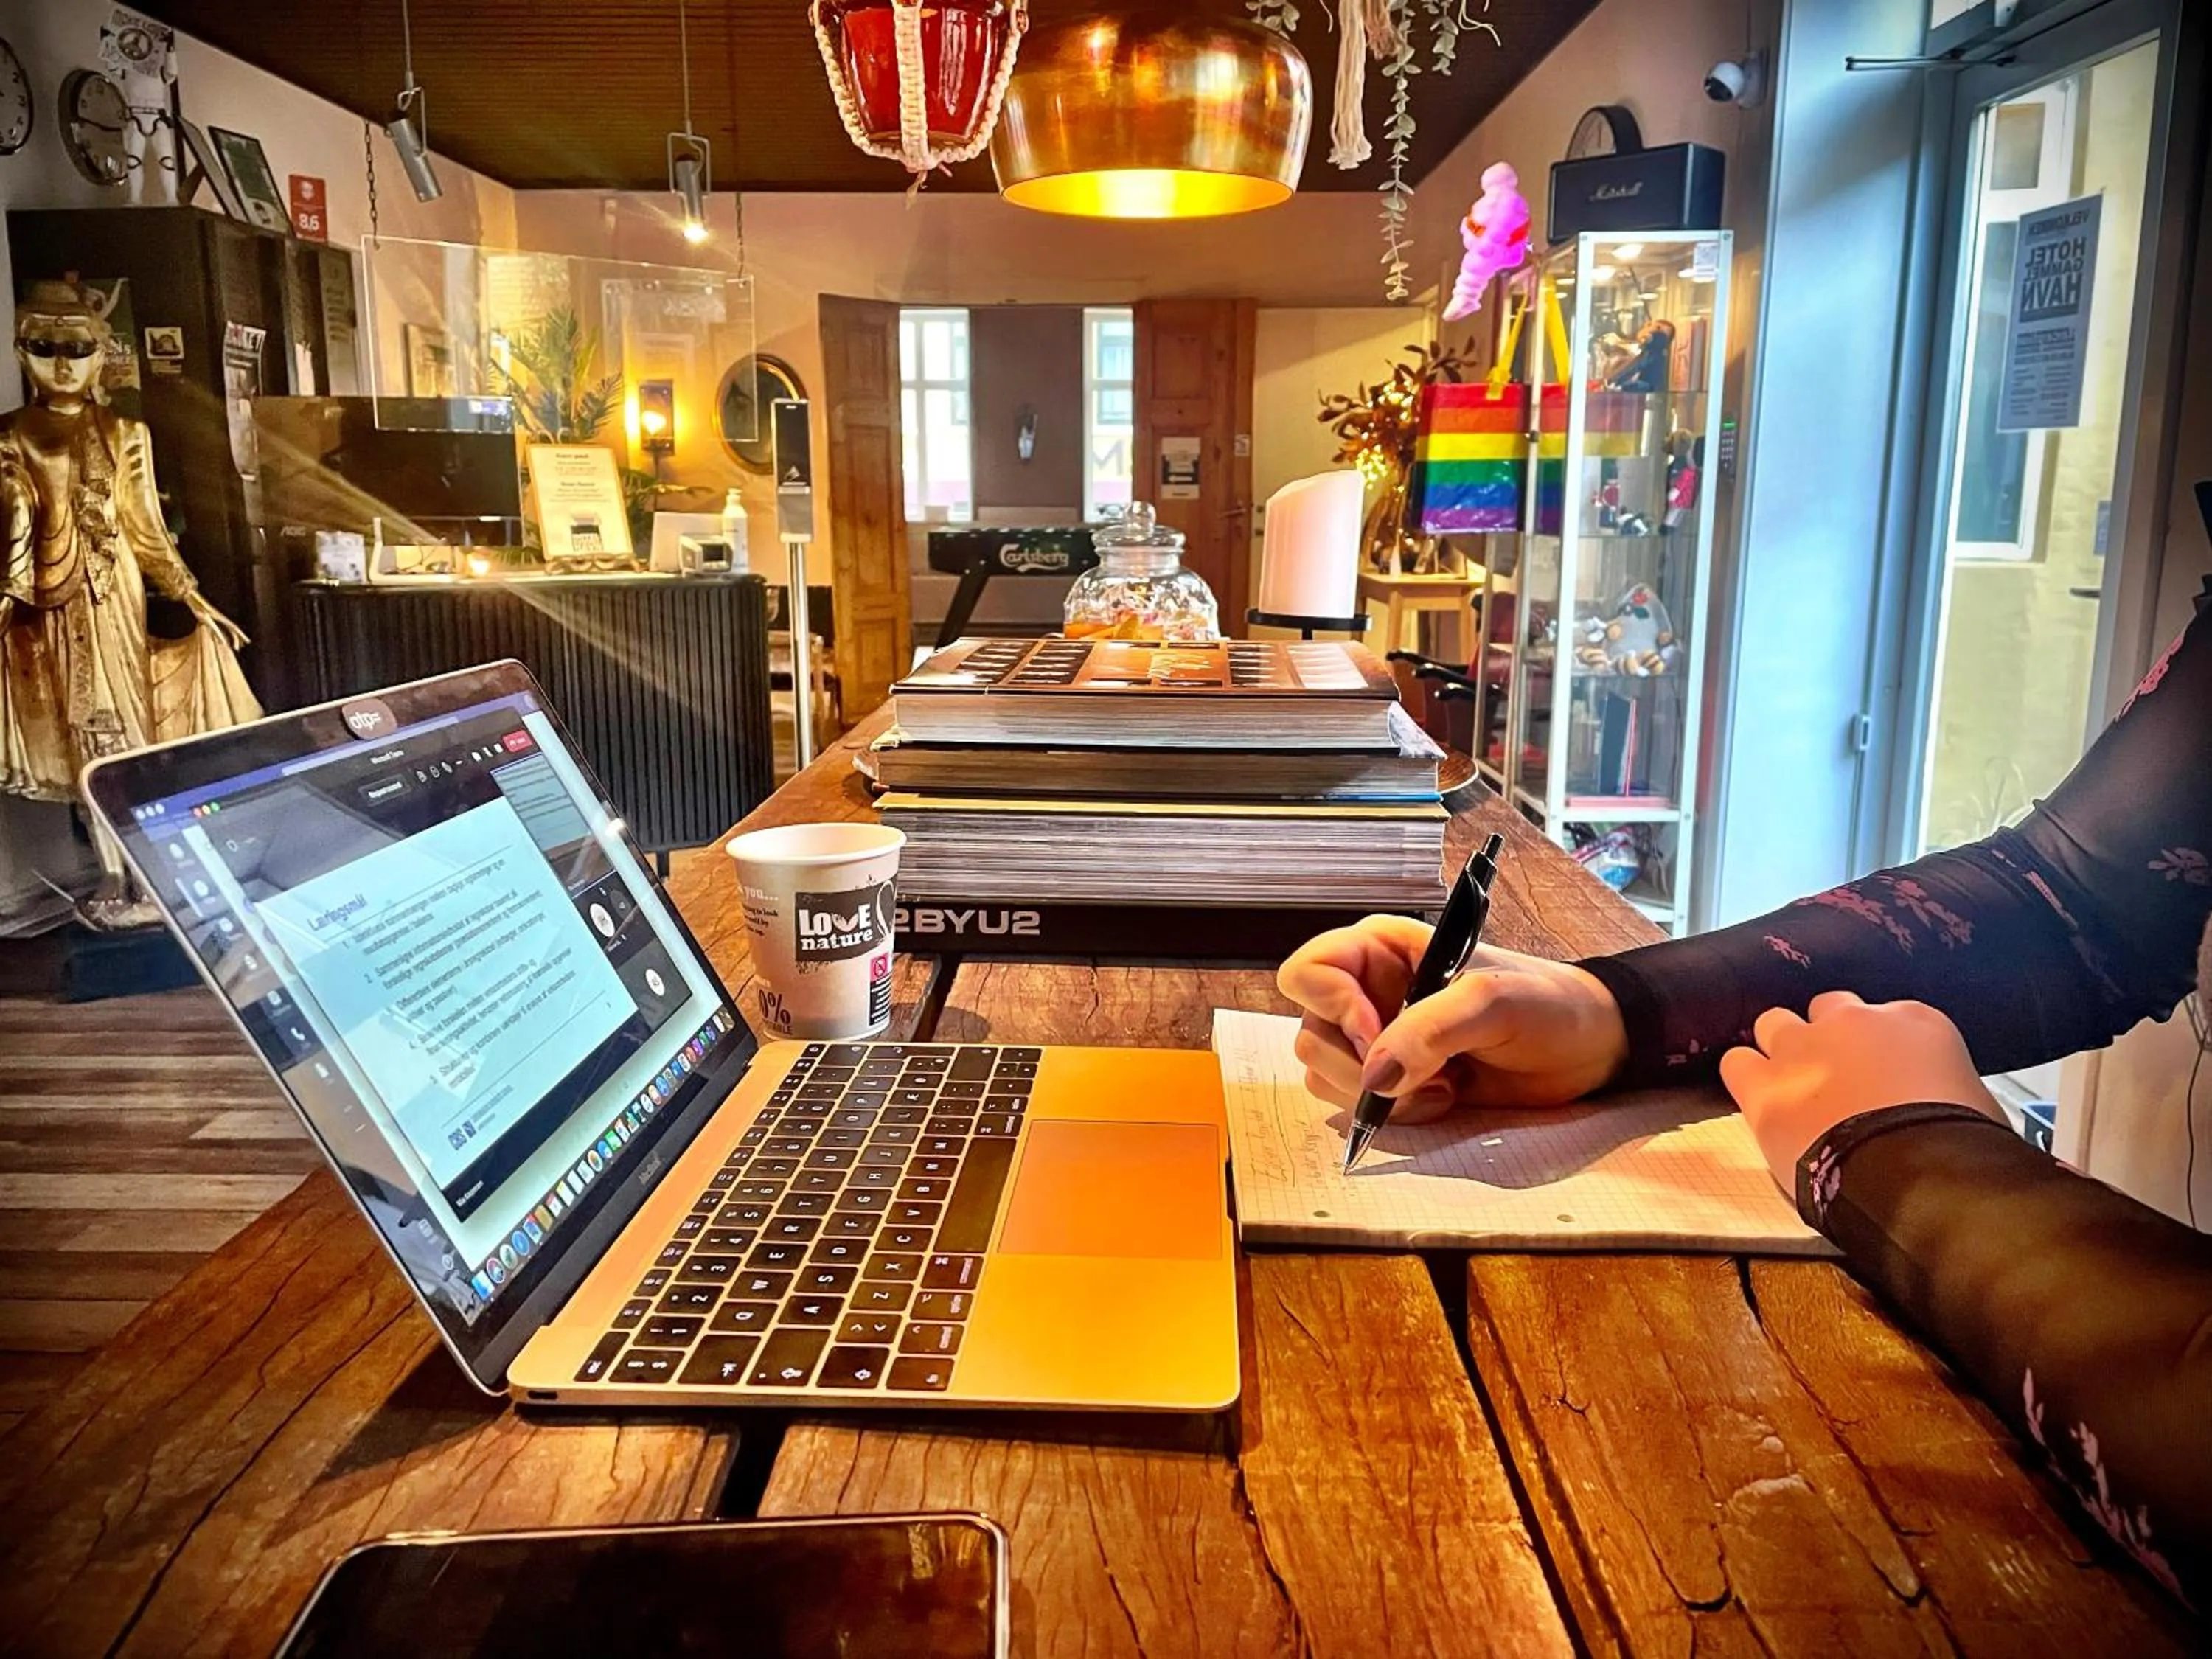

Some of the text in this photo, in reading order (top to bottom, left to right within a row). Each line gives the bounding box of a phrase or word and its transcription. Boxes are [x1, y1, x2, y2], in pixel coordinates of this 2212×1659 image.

[1000, 543, 1069, 571] Carlsberg
[799, 903, 871, 936] LOVE
[894, 908, 1041, 935] 2BYU2
[801, 928, 873, 950] nature
[925, 1162, 939, 1170] N
[844, 1220, 858, 1228] F
[895, 1234, 911, 1242] C
[830, 1246, 846, 1254] D
[884, 1262, 901, 1270] X
[817, 1274, 834, 1282] S
[751, 1279, 769, 1290] W
[691, 1294, 709, 1302] 2
[872, 1291, 889, 1299] Z
[802, 1305, 821, 1314] A
[734, 1311, 754, 1321] Q
